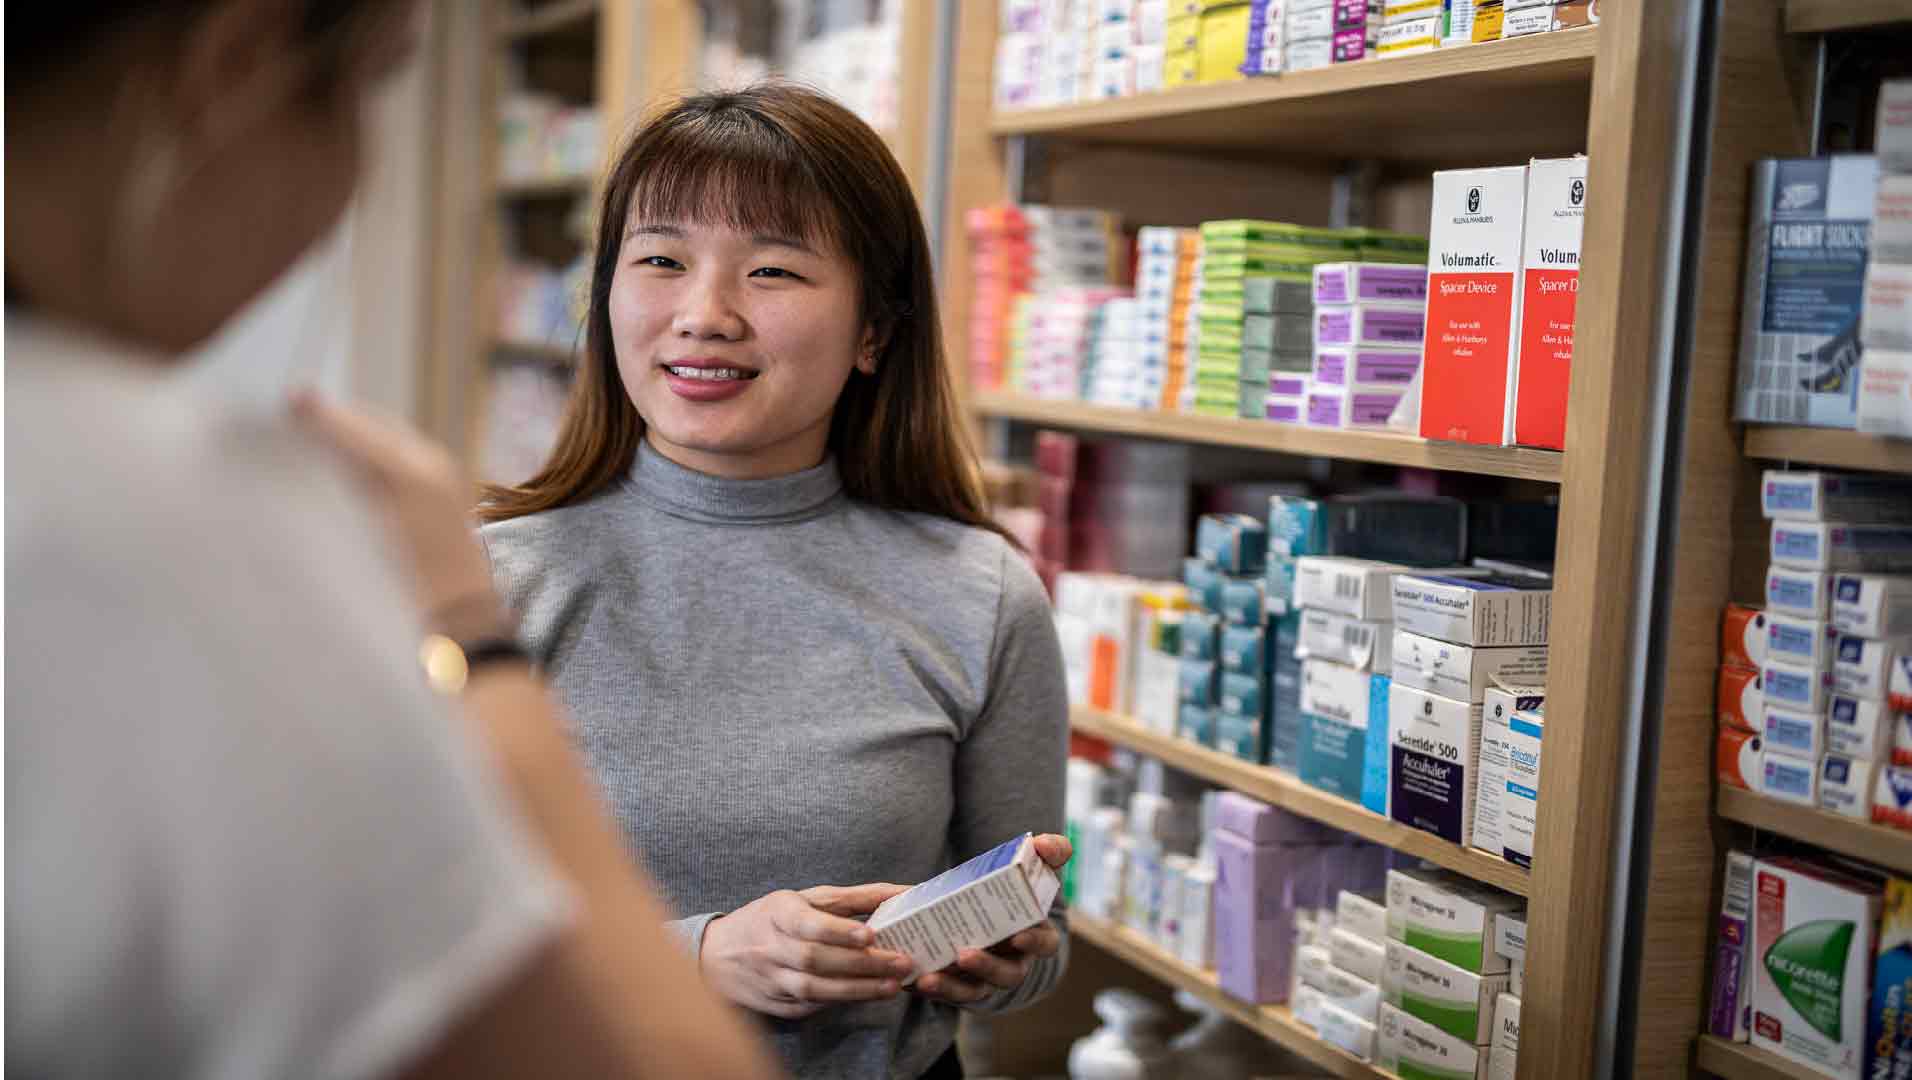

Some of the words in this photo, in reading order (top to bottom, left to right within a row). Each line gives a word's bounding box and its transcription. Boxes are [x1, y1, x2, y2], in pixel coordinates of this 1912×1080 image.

[1441, 251, 1495, 267] Volumatic
[1540, 248, 1582, 264] Volum
[1440, 280, 1466, 297] Spacer
[1468, 280, 1497, 294] Device
[1539, 277, 1568, 295] Spacer
[1570, 277, 1579, 293] D
[1438, 742, 1458, 761] 500
